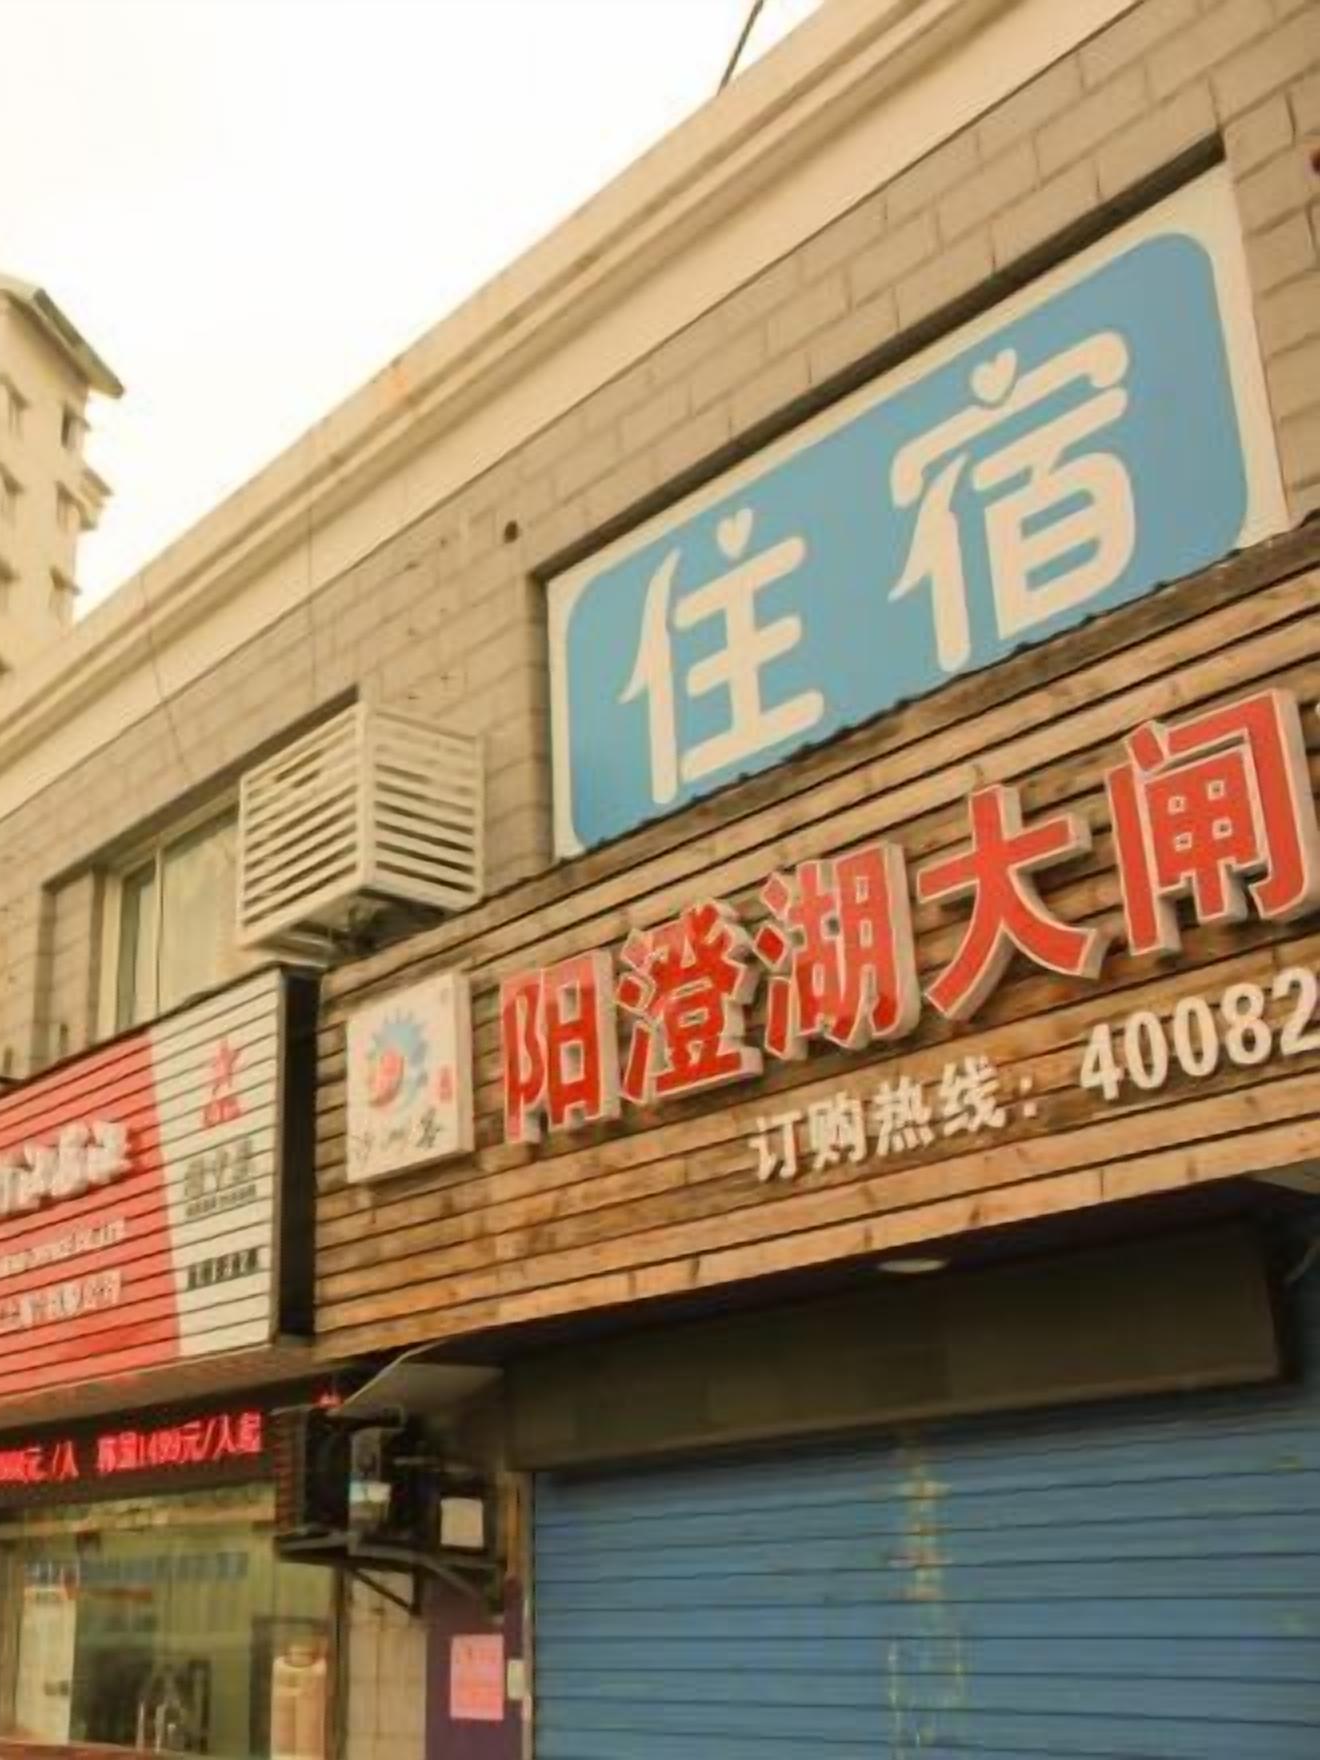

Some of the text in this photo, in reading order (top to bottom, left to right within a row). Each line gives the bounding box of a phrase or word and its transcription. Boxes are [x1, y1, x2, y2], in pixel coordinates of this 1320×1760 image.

[619, 331, 1137, 805] 住宿
[500, 688, 1320, 1143] 阳澄湖大闸
